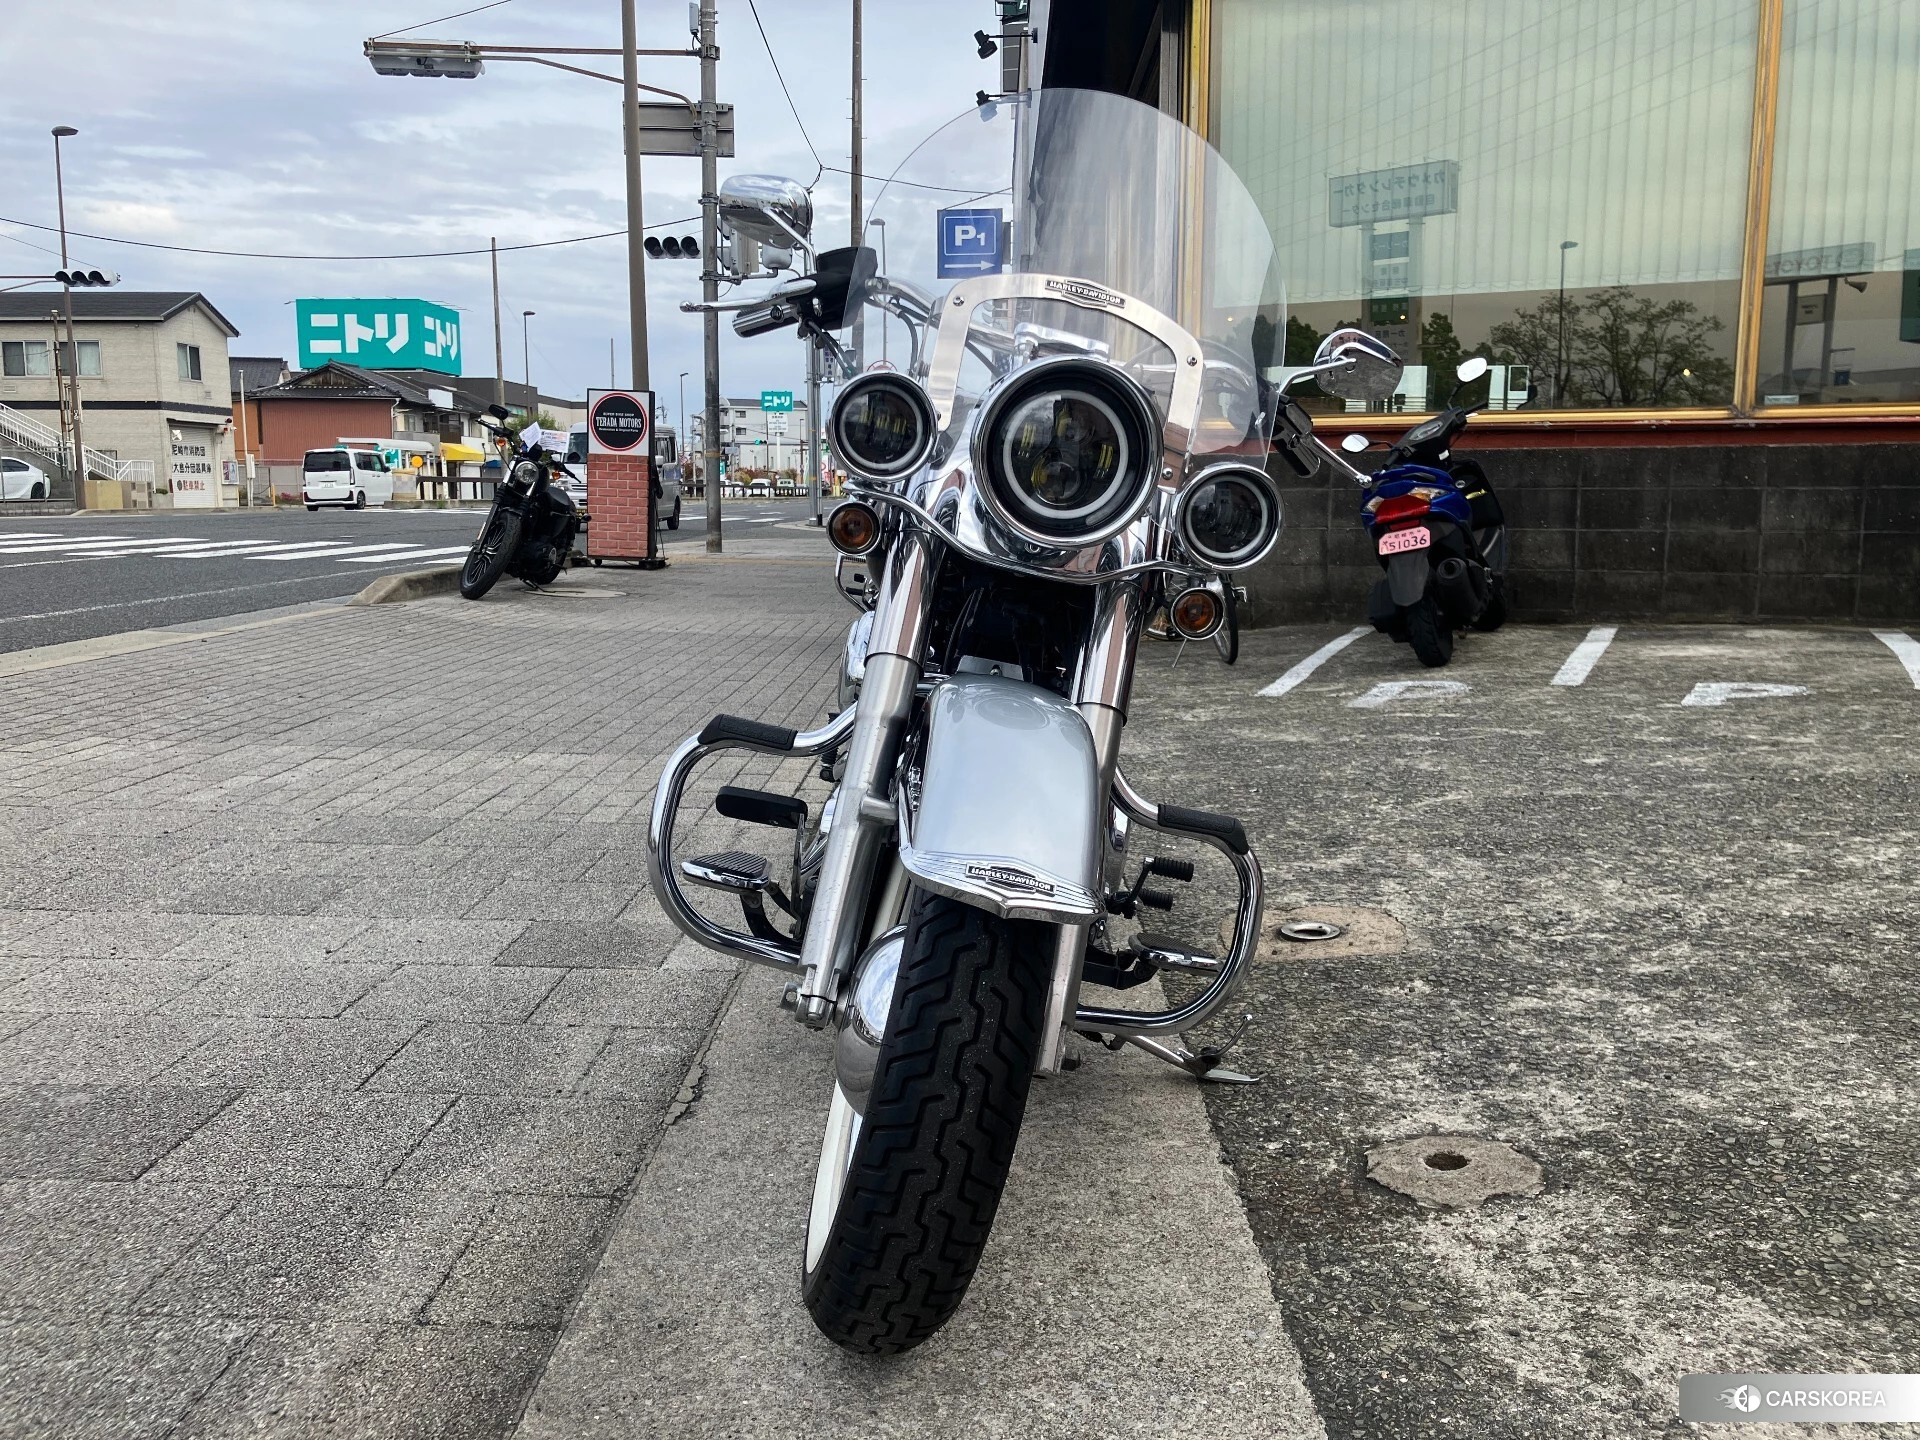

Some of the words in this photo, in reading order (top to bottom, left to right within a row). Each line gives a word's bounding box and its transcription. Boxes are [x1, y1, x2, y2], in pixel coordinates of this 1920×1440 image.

[954, 225, 986, 246] P1
[309, 313, 410, 354] ニトリ
[423, 315, 458, 361] ニトリ
[764, 396, 790, 407] ニトリ
[596, 416, 617, 427] TERADA
[619, 417, 642, 428] MOTORS
[1389, 534, 1427, 551] 51036
